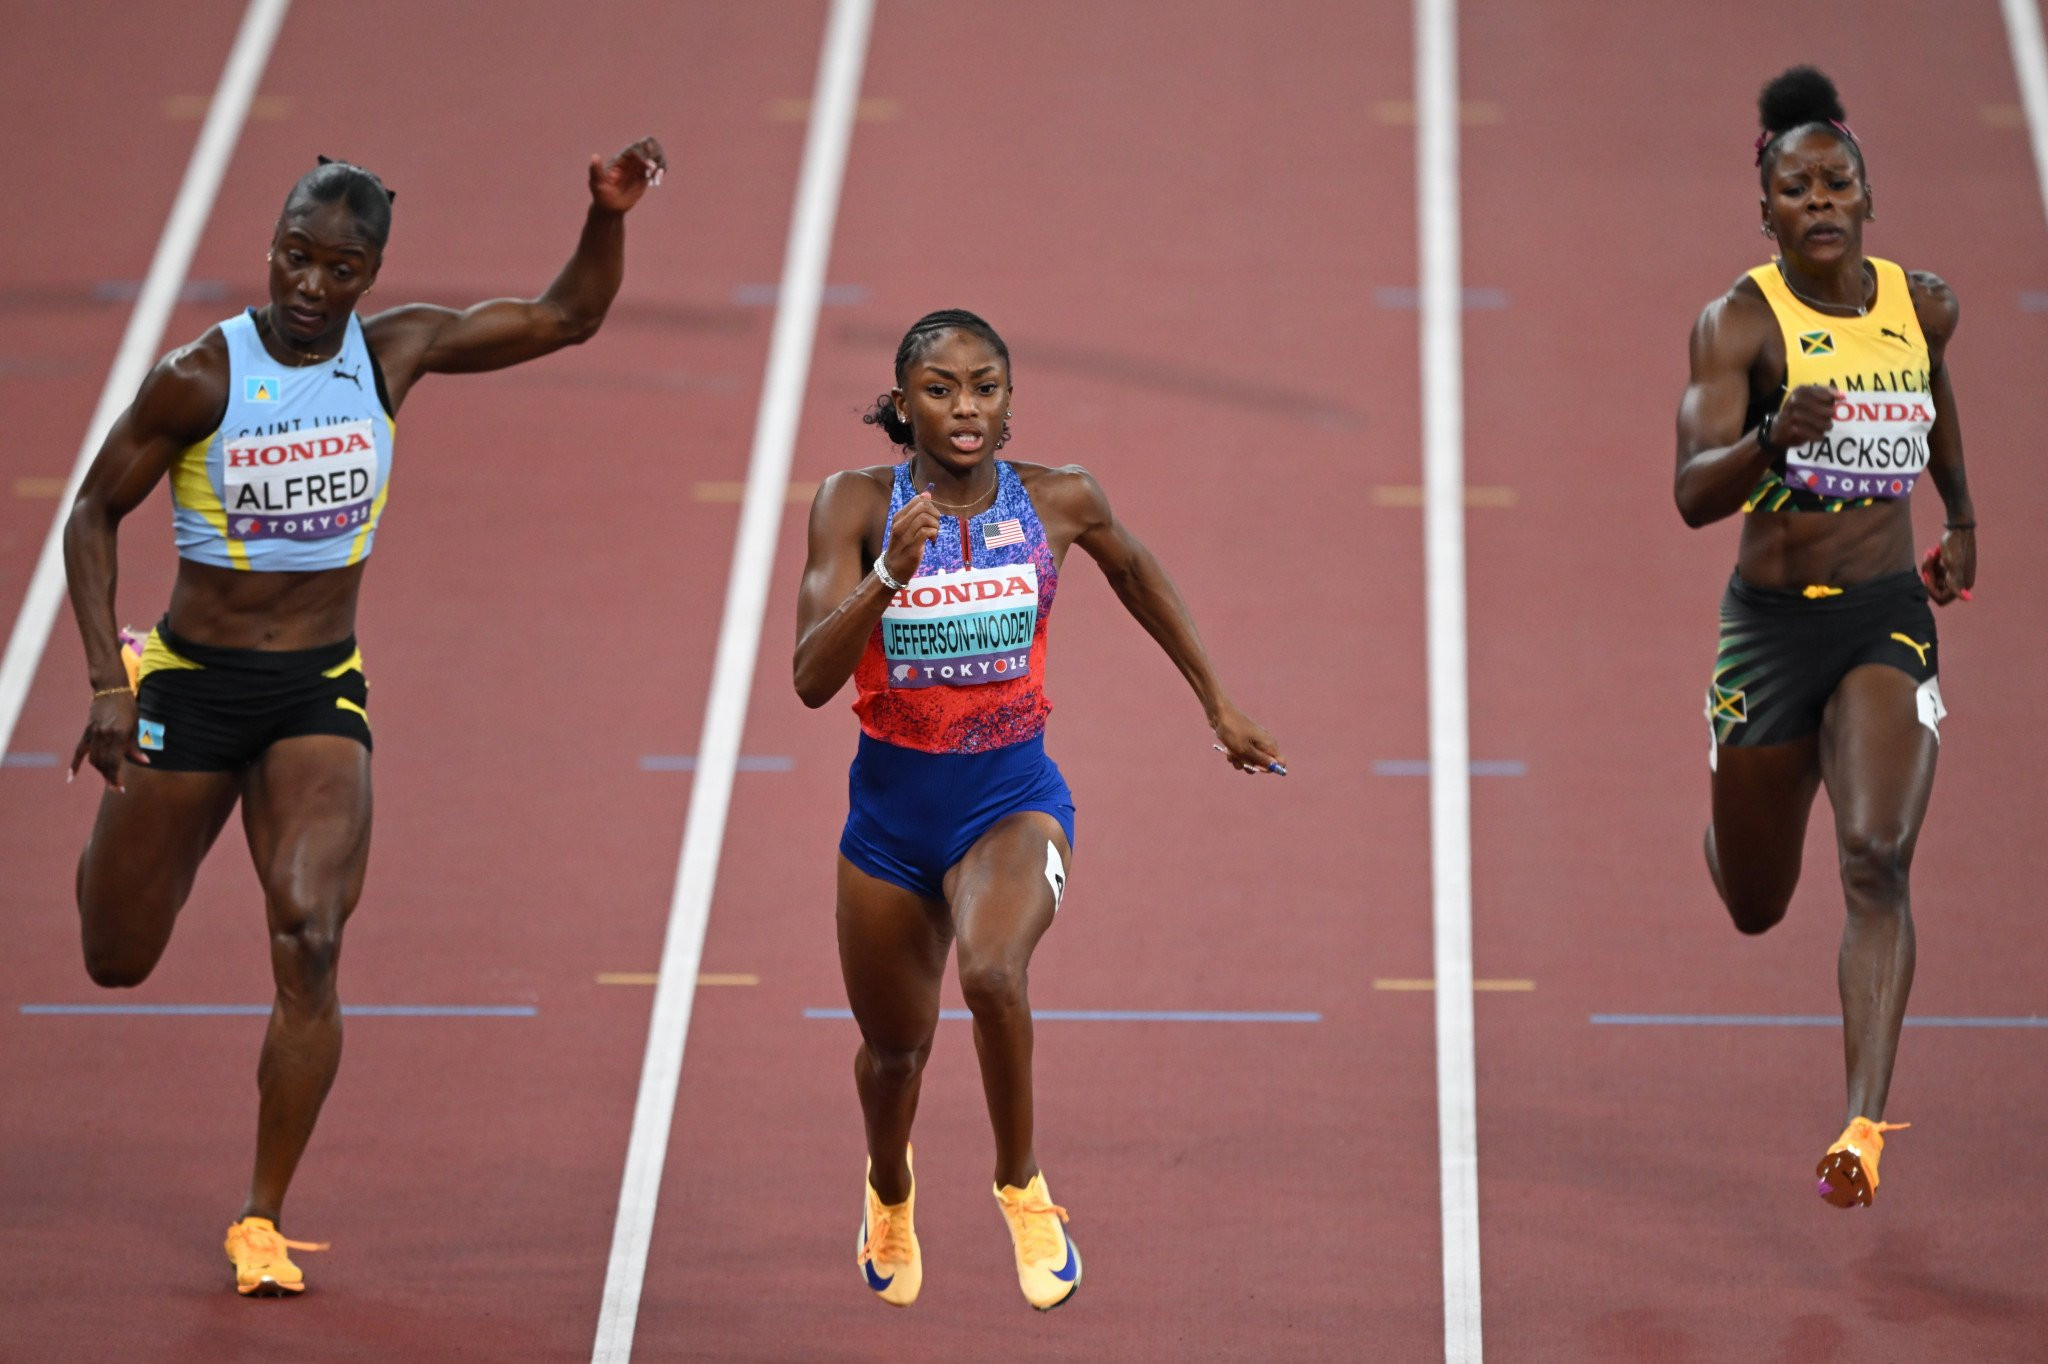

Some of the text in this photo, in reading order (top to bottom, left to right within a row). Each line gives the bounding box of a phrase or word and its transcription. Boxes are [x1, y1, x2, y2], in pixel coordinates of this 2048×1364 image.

[1814, 369, 1931, 394] AMAICA
[1832, 402, 1931, 422] ONDA
[228, 432, 371, 467] HONDA
[1797, 436, 1925, 468] JACKSON
[235, 468, 368, 510] ALFRED
[888, 576, 1034, 608] HONDA
[889, 610, 1033, 655] JEFFERSON-WOODEN
